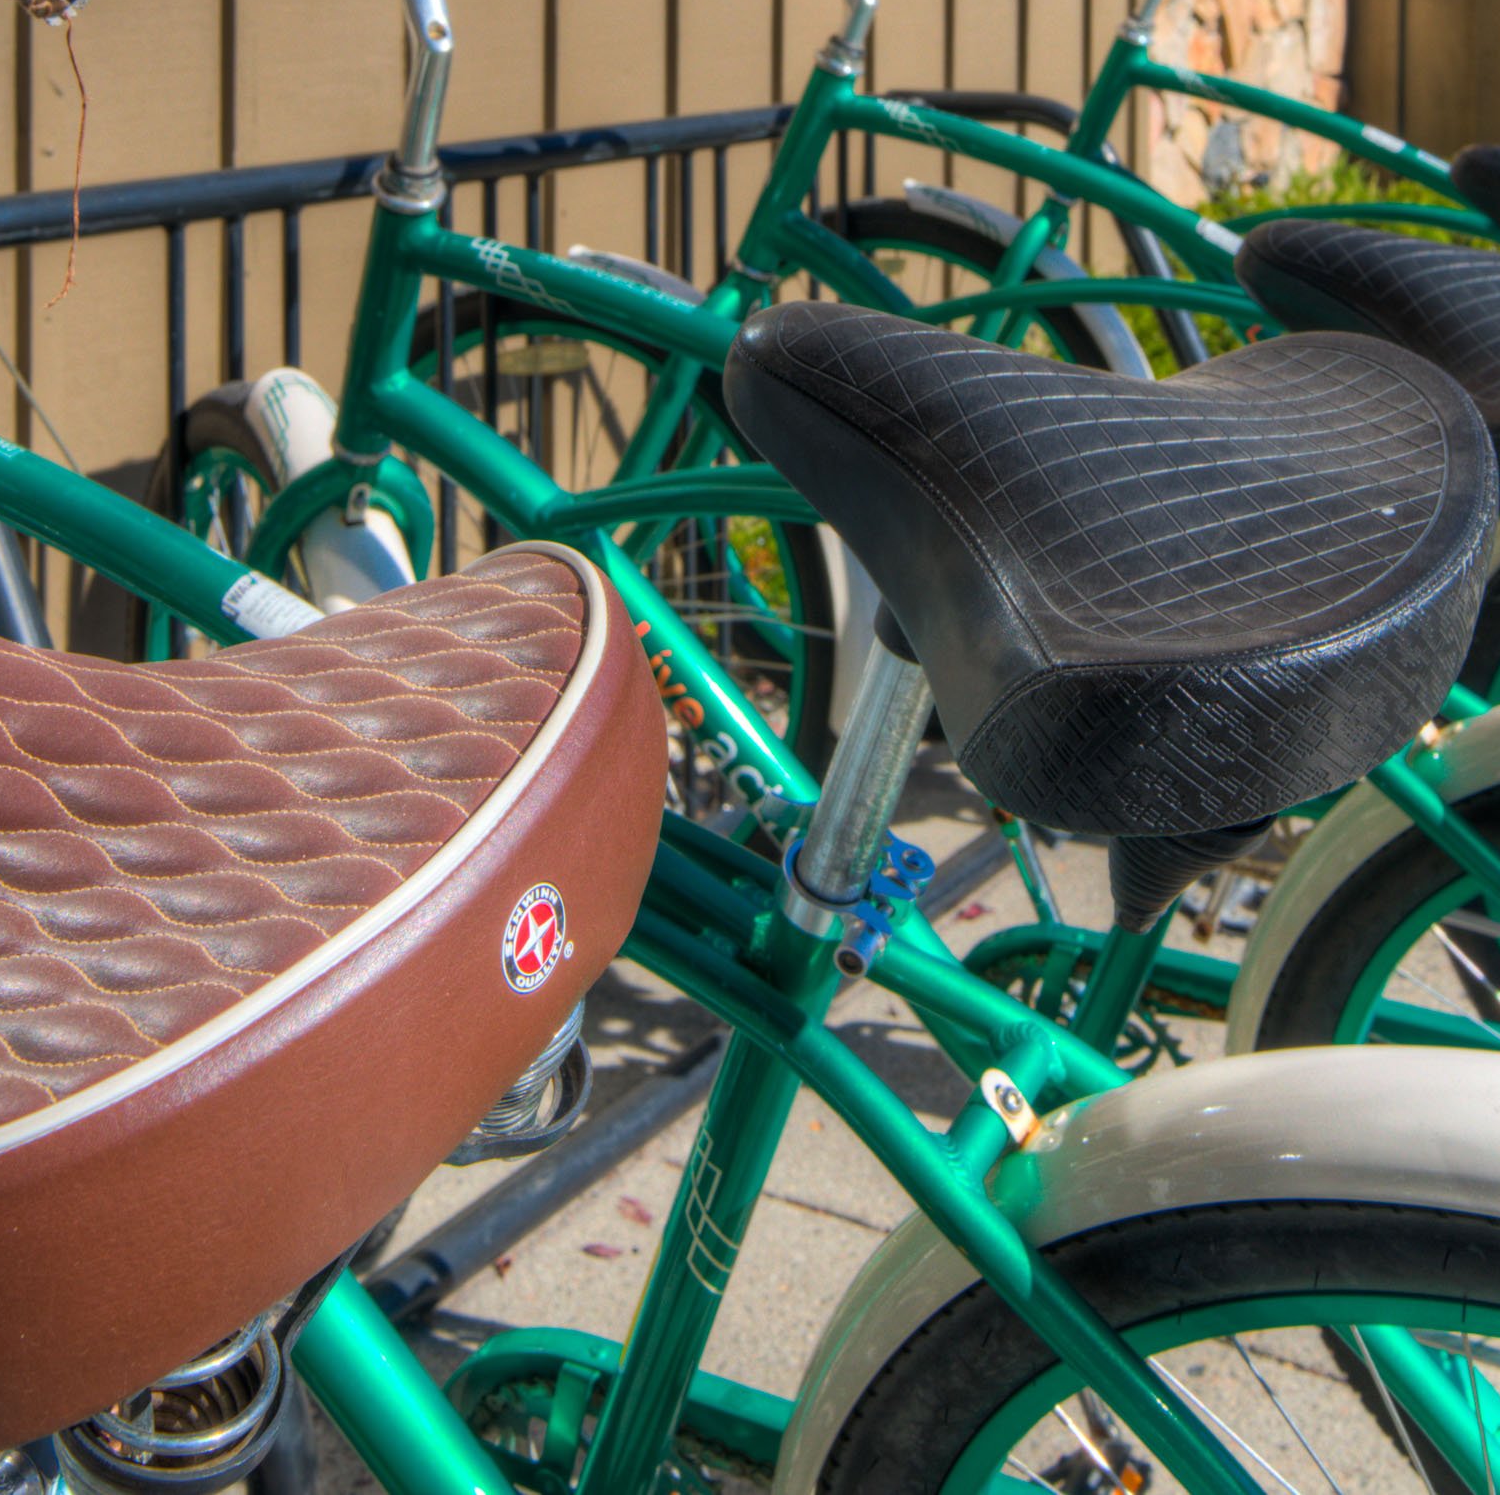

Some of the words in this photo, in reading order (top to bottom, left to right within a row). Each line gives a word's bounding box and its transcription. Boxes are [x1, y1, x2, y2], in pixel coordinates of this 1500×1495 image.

[634, 620, 705, 730] ive
[504, 886, 558, 957] SCHWINN
[515, 930, 563, 989] QUALITY
